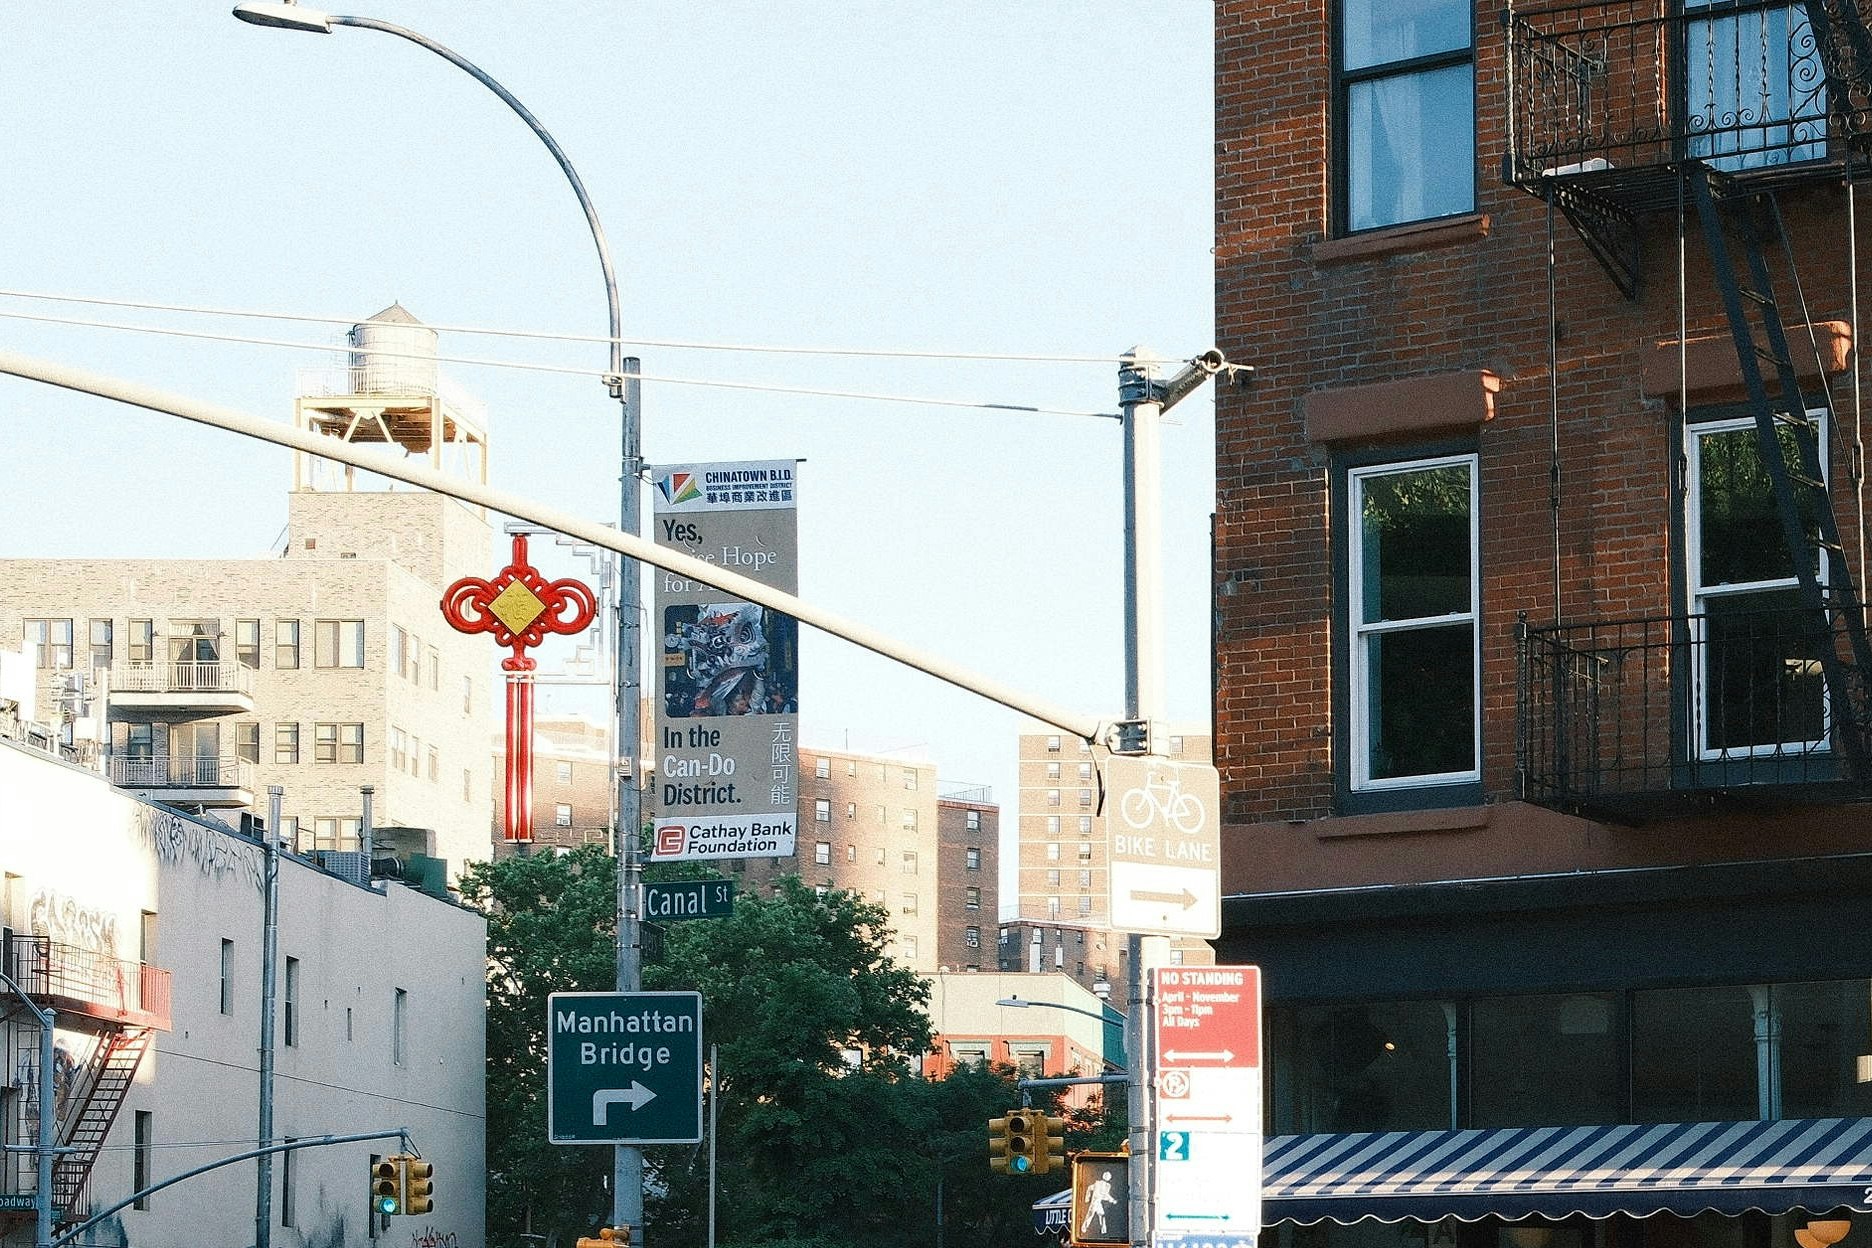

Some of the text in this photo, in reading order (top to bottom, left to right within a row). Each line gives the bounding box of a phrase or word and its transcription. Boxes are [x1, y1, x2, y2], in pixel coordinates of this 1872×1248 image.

[705, 469, 793, 484] CHINATOWN B.I.D.
[705, 484, 731, 492] BUSINESS
[731, 483, 768, 491] IMPROVEMENT
[706, 489, 793, 504] 華埠商業改進區
[663, 519, 703, 544] Yes,
[722, 546, 777, 571] Hope
[664, 573, 693, 593] for
[664, 724, 721, 749] In the
[663, 752, 736, 778] Can-Do
[769, 722, 792, 806] 无限可能
[664, 782, 742, 806] District.
[689, 821, 792, 841] Cathay Bank
[688, 838, 777, 855] Foundation
[1115, 834, 1213, 862] BIKE LANE
[648, 884, 728, 916] Canal St
[1161, 971, 1244, 986] NO STANDING
[1162, 991, 1185, 1003] April
[1192, 991, 1239, 1003] November
[557, 1009, 693, 1034] Manhattan
[1162, 1004, 1183, 1016] 3pm
[1162, 1016, 1200, 1029] All Days
[581, 1042, 671, 1072] Bridge
[1166, 1132, 1184, 1160] 2
